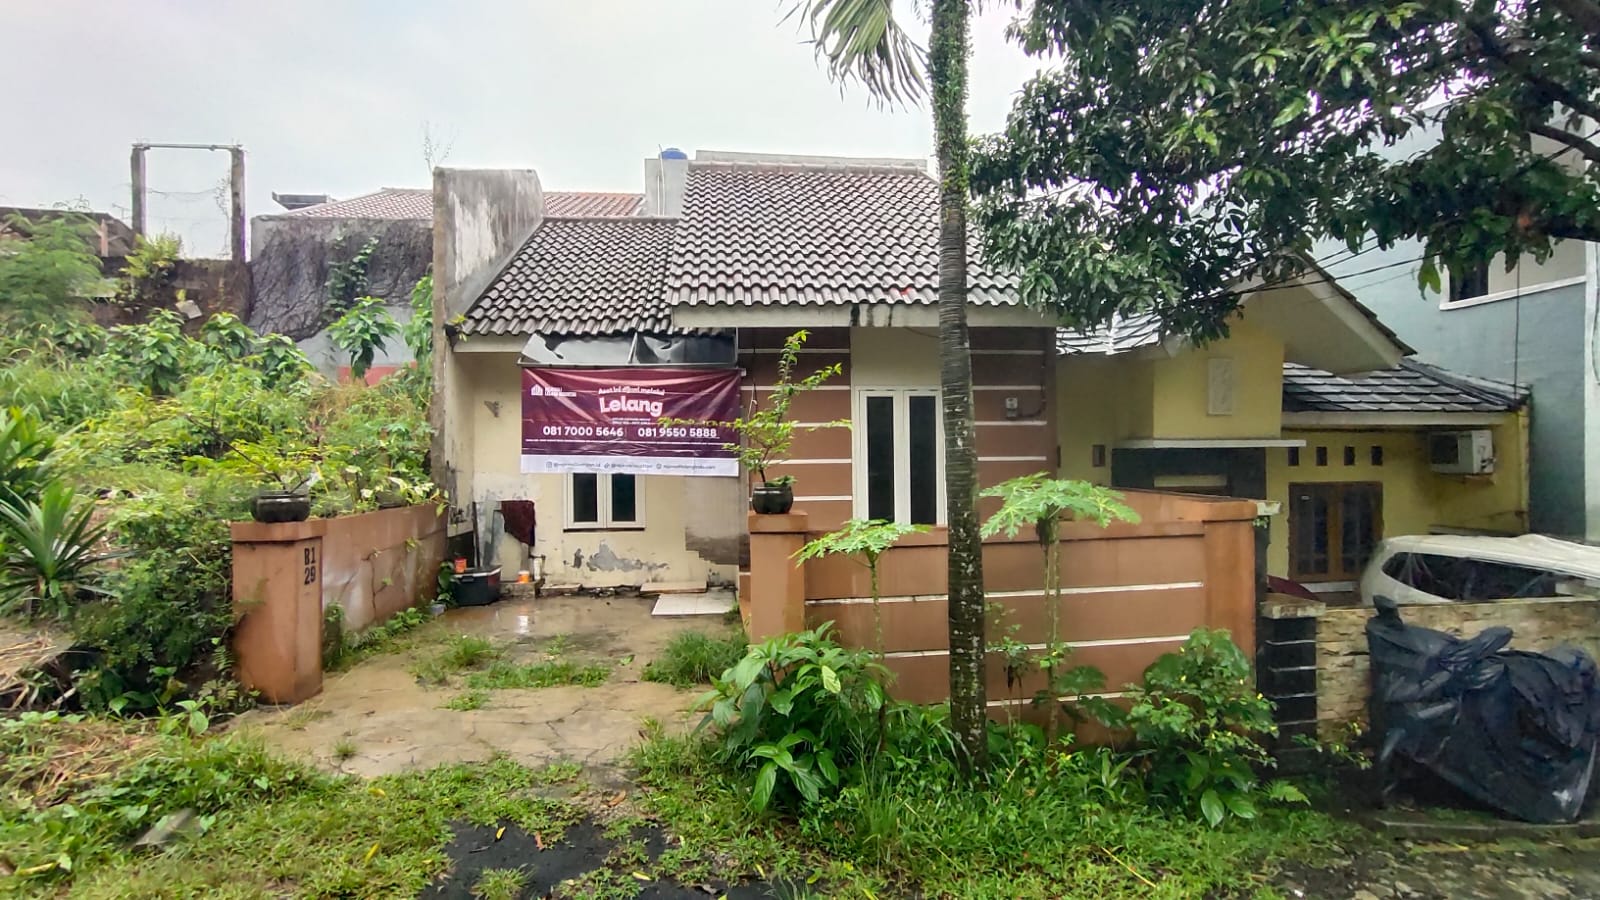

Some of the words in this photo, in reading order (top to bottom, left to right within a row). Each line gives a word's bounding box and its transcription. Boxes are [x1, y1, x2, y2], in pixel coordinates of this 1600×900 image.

[599, 395, 663, 417] Lelang
[543, 425, 562, 436] 081
[564, 425, 593, 436] 7000
[595, 426, 624, 437] 5646
[637, 427, 657, 437] 081
[659, 427, 687, 437] 9550
[689, 428, 717, 438] 5888
[304, 547, 316, 566] B1
[304, 565, 316, 585] 29
